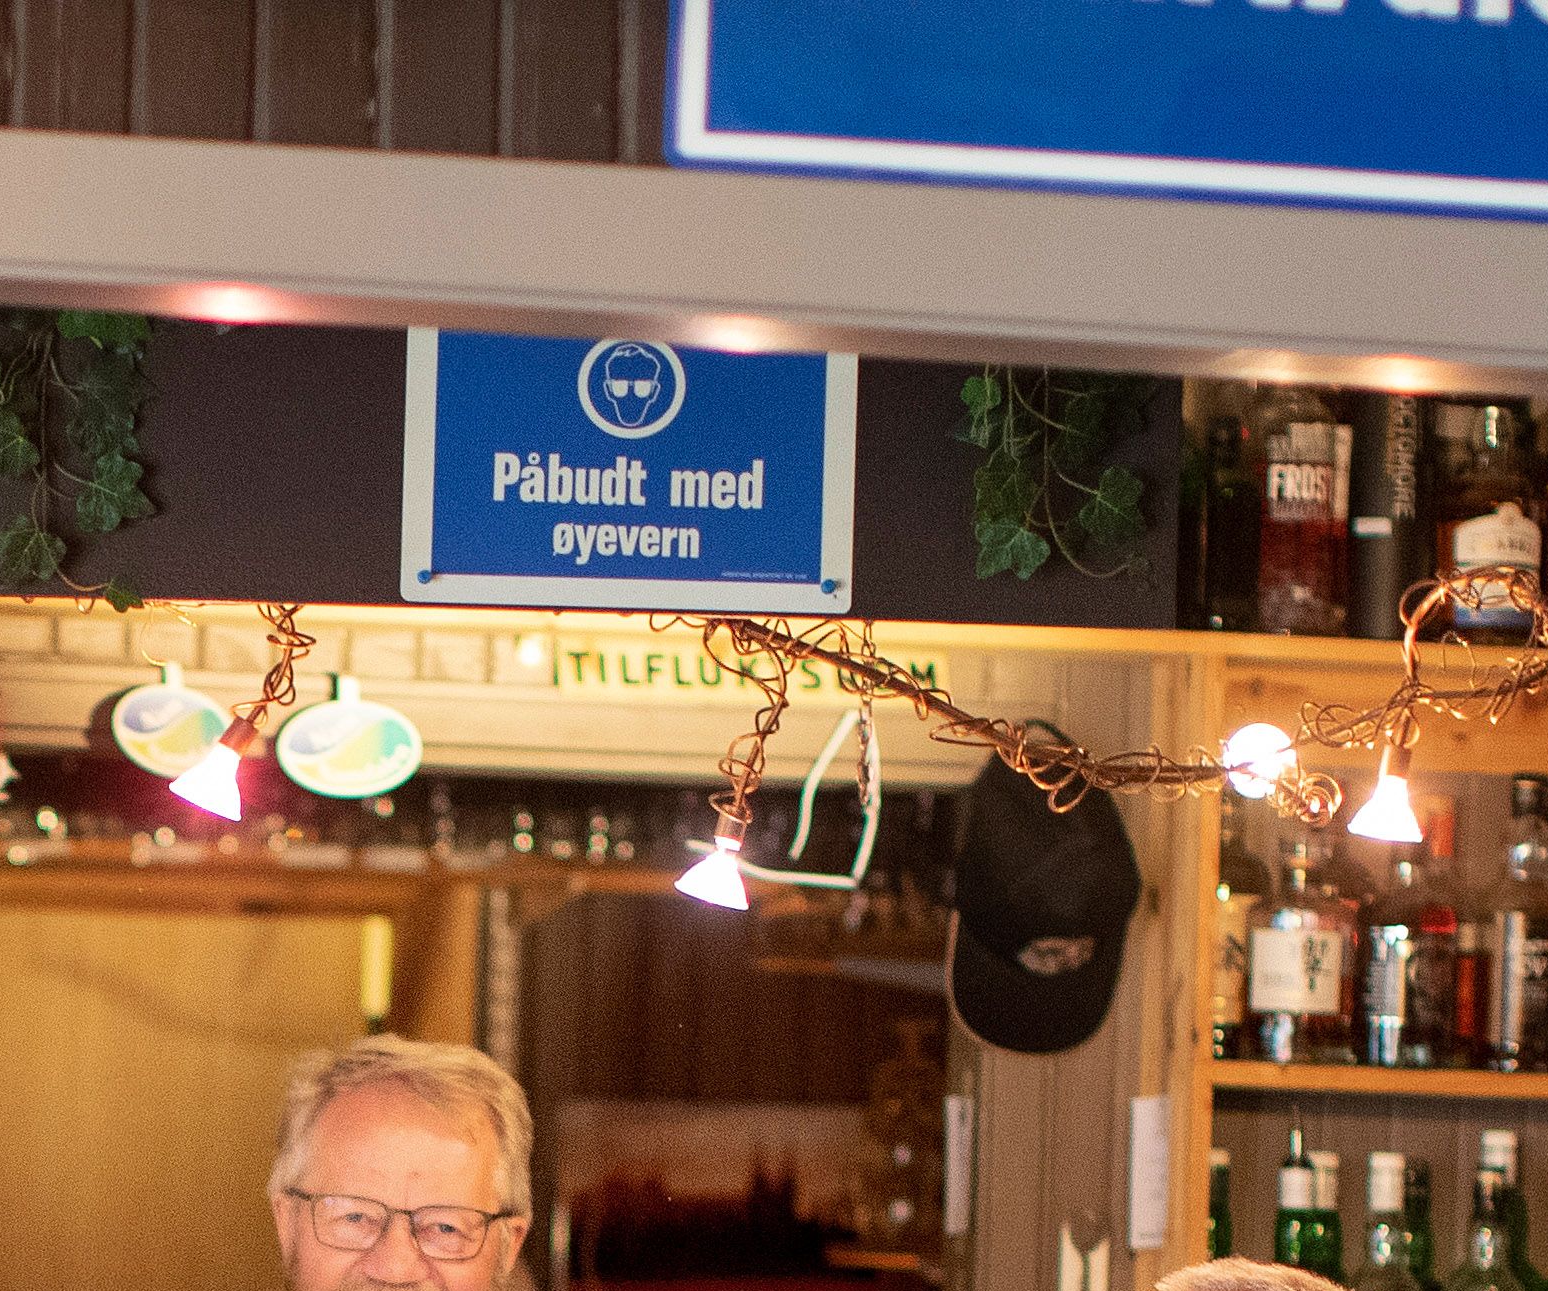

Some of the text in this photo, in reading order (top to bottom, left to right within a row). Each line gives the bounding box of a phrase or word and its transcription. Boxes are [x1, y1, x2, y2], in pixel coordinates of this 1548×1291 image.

[492, 452, 764, 510] Påbudt med
[551, 521, 701, 566] øyevern
[566, 650, 938, 690] TILFLUKSM
